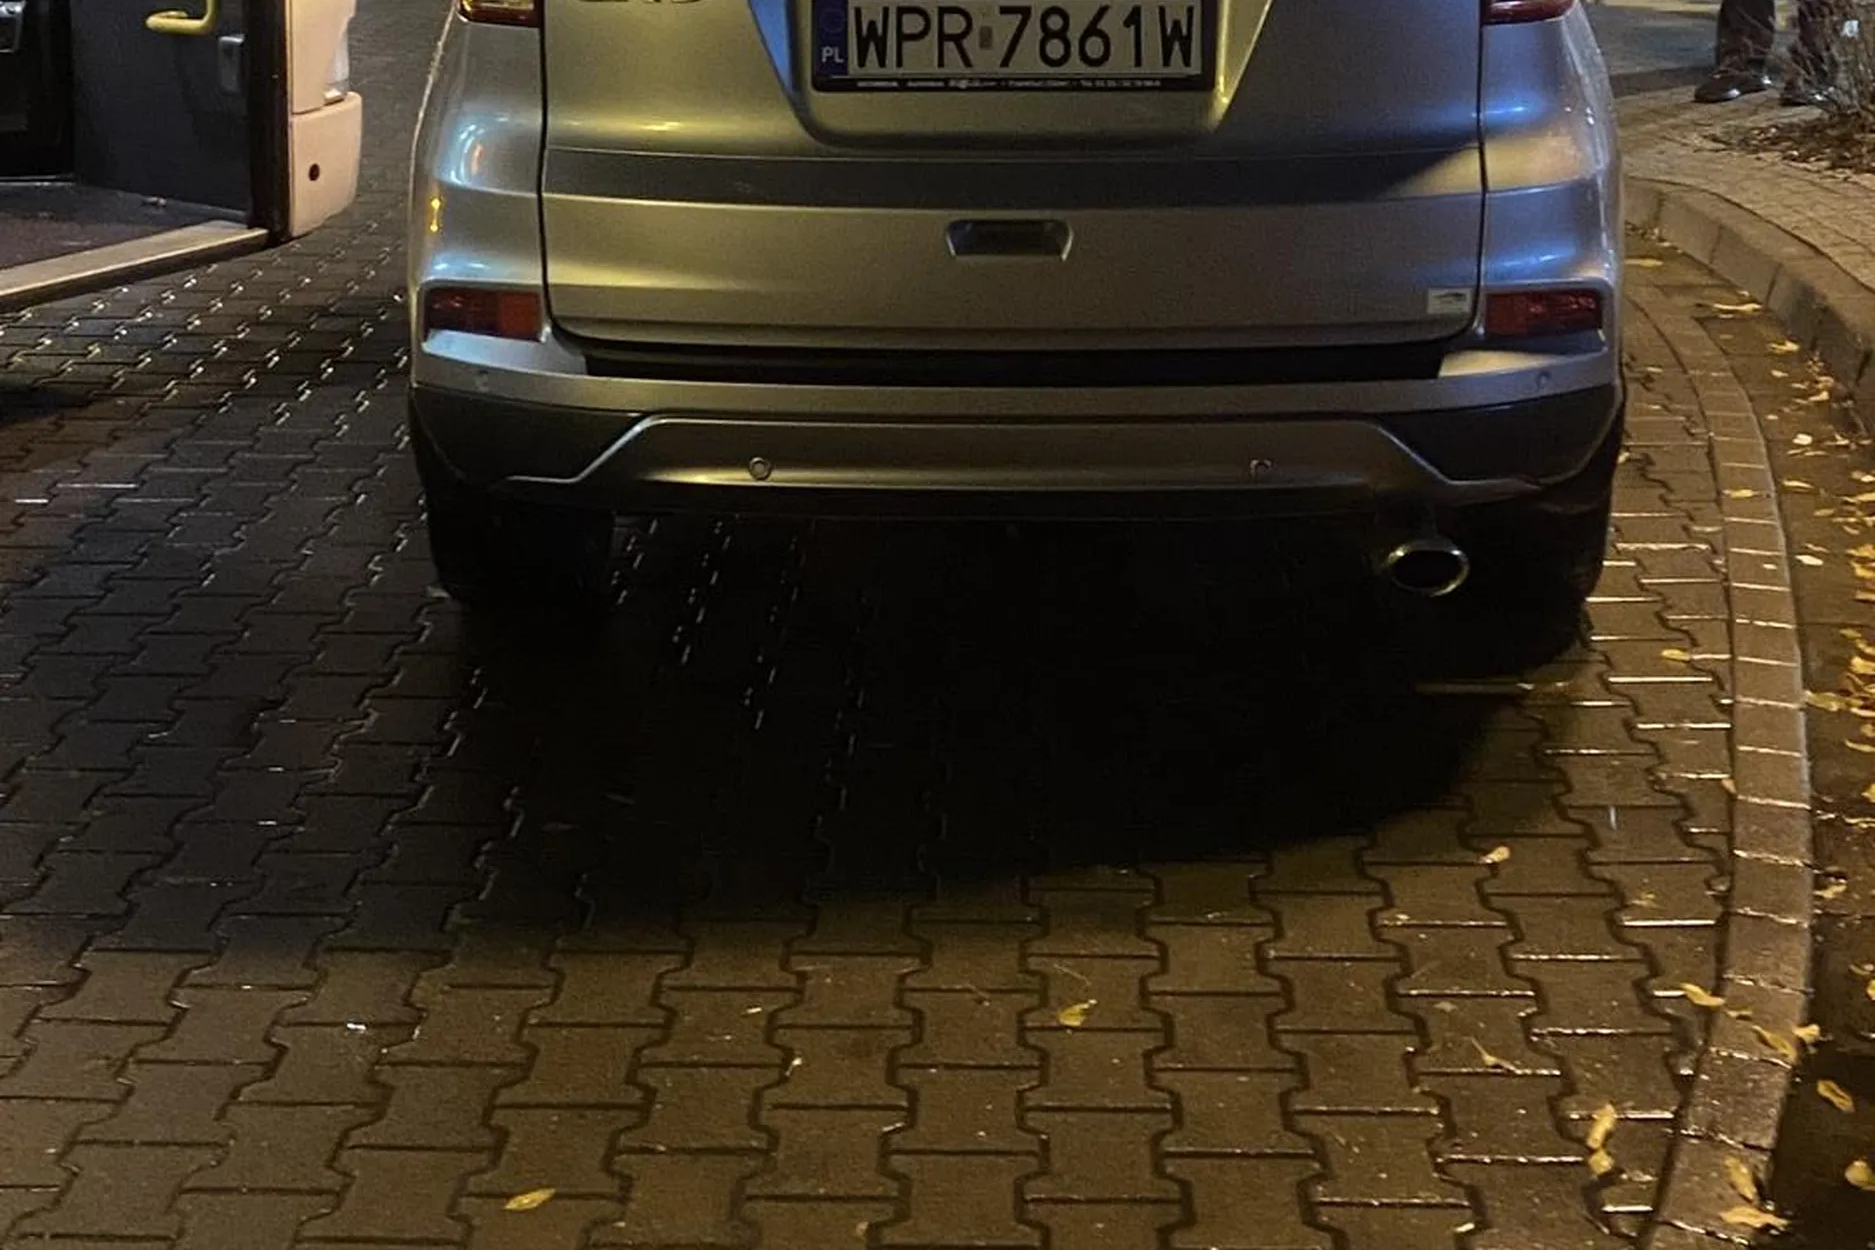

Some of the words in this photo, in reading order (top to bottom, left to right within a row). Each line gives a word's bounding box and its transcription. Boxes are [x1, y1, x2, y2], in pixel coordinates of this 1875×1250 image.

[821, 47, 844, 63] PL
[854, 5, 974, 68] WPR
[998, 5, 1194, 68] 7861W
